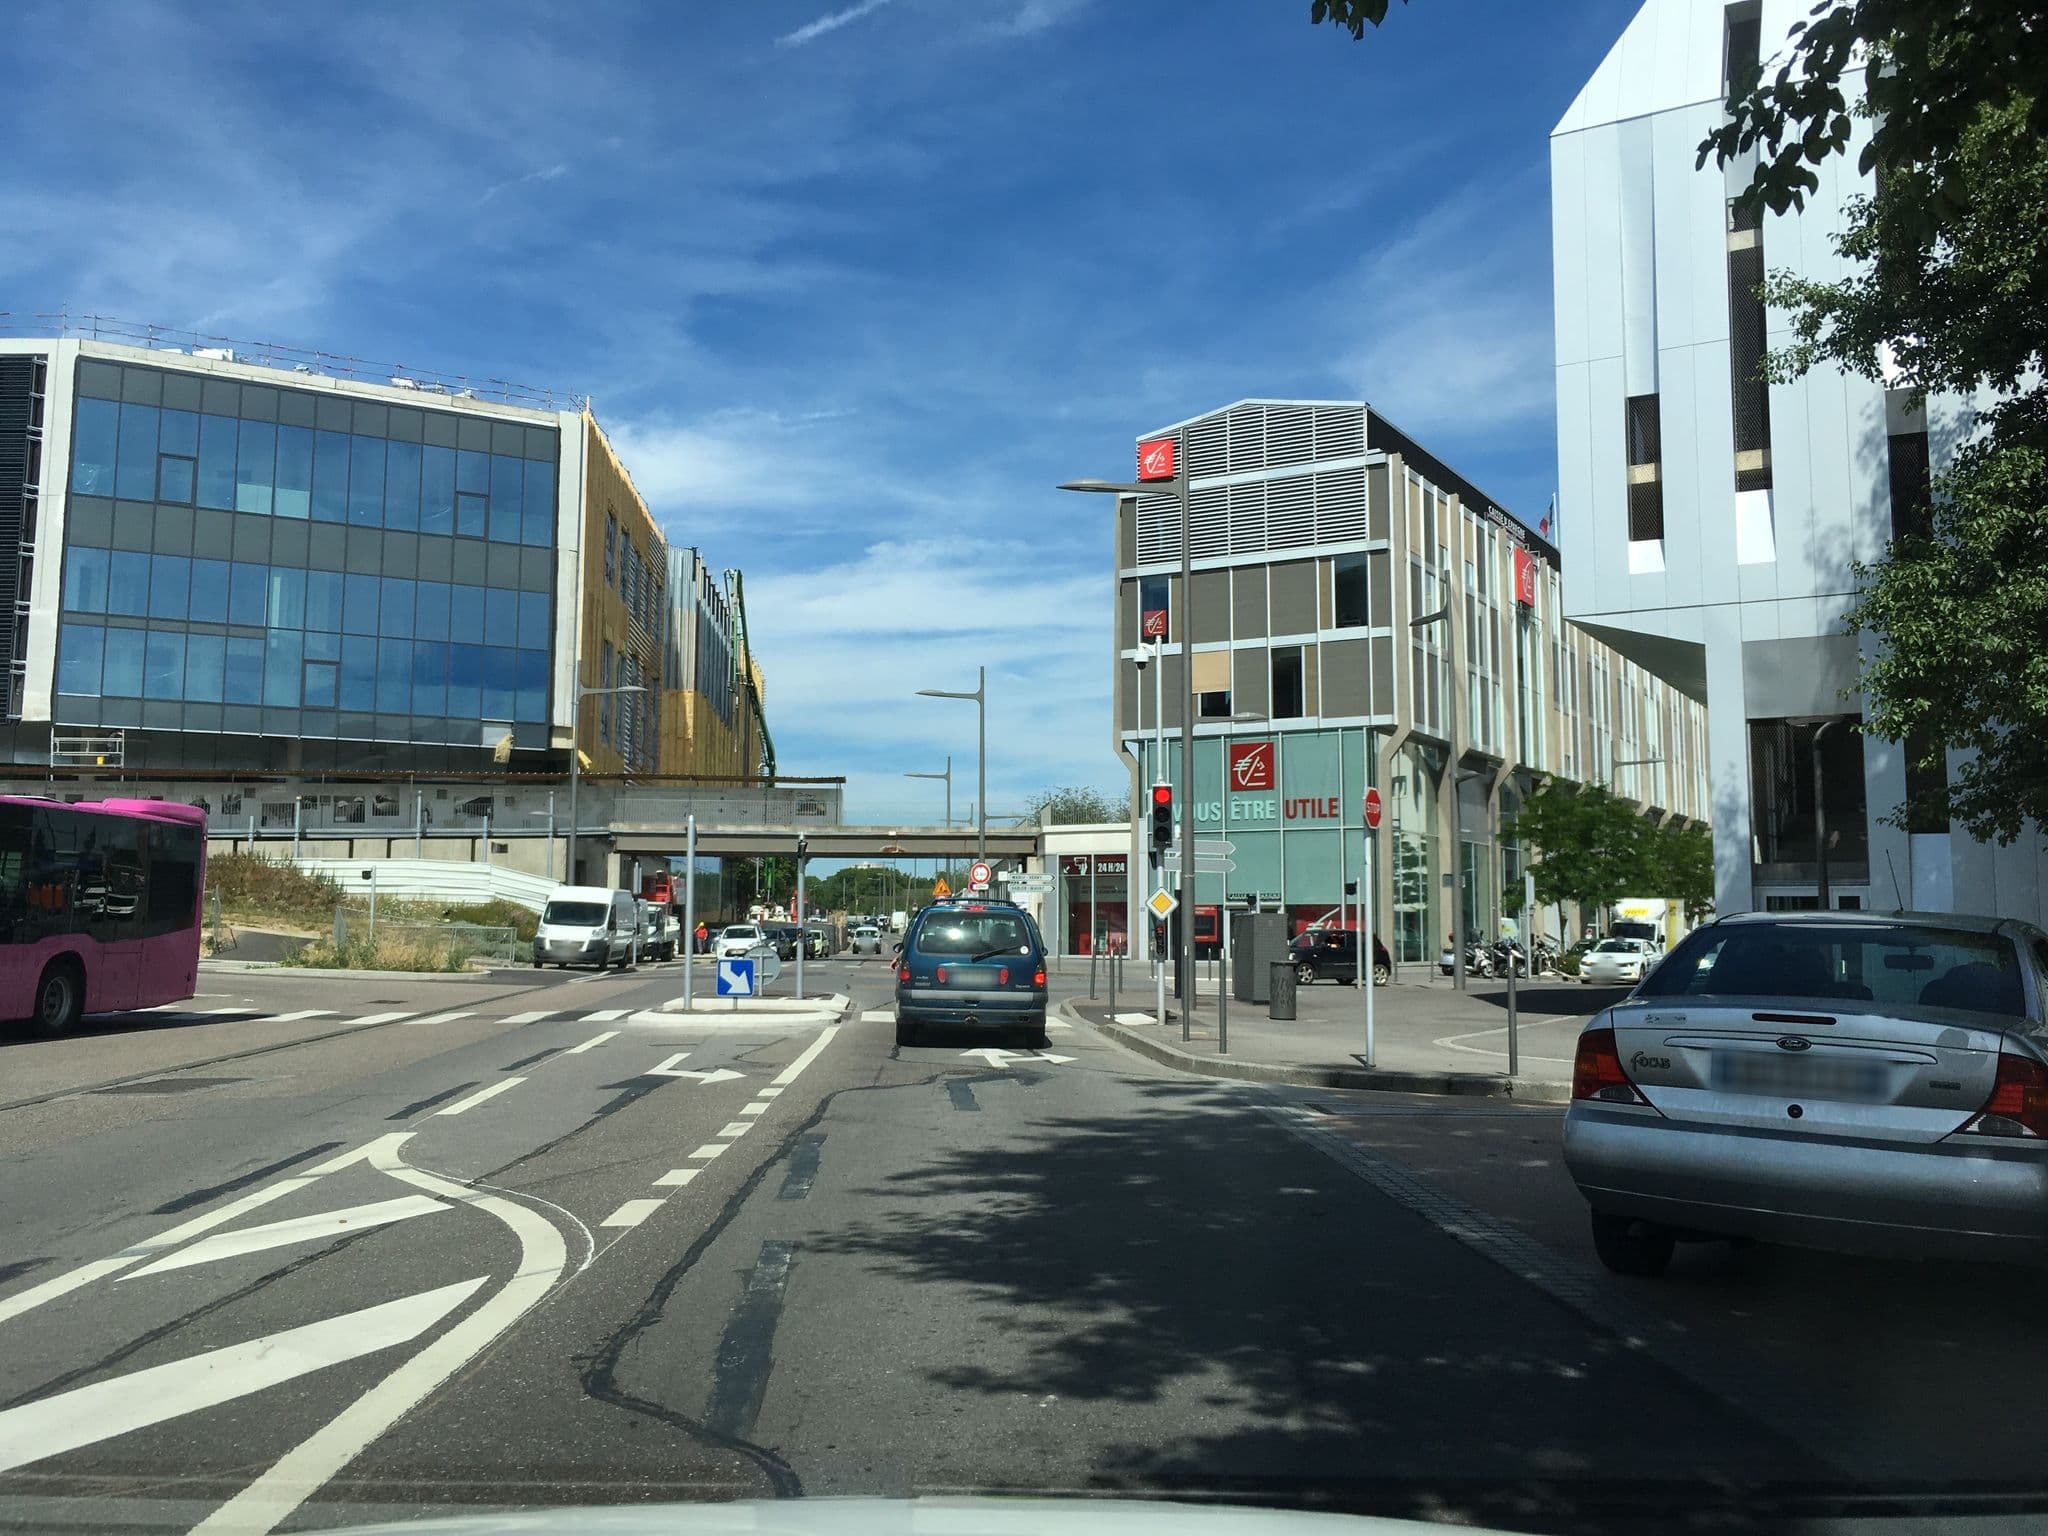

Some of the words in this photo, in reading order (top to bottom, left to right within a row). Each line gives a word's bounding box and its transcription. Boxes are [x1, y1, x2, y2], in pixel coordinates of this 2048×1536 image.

[1172, 802, 1221, 822] VUS
[1231, 796, 1276, 821] ÊTRE
[1285, 797, 1339, 819] UTILE
[1367, 801, 1380, 814] STOP
[1097, 862, 1108, 873] 24
